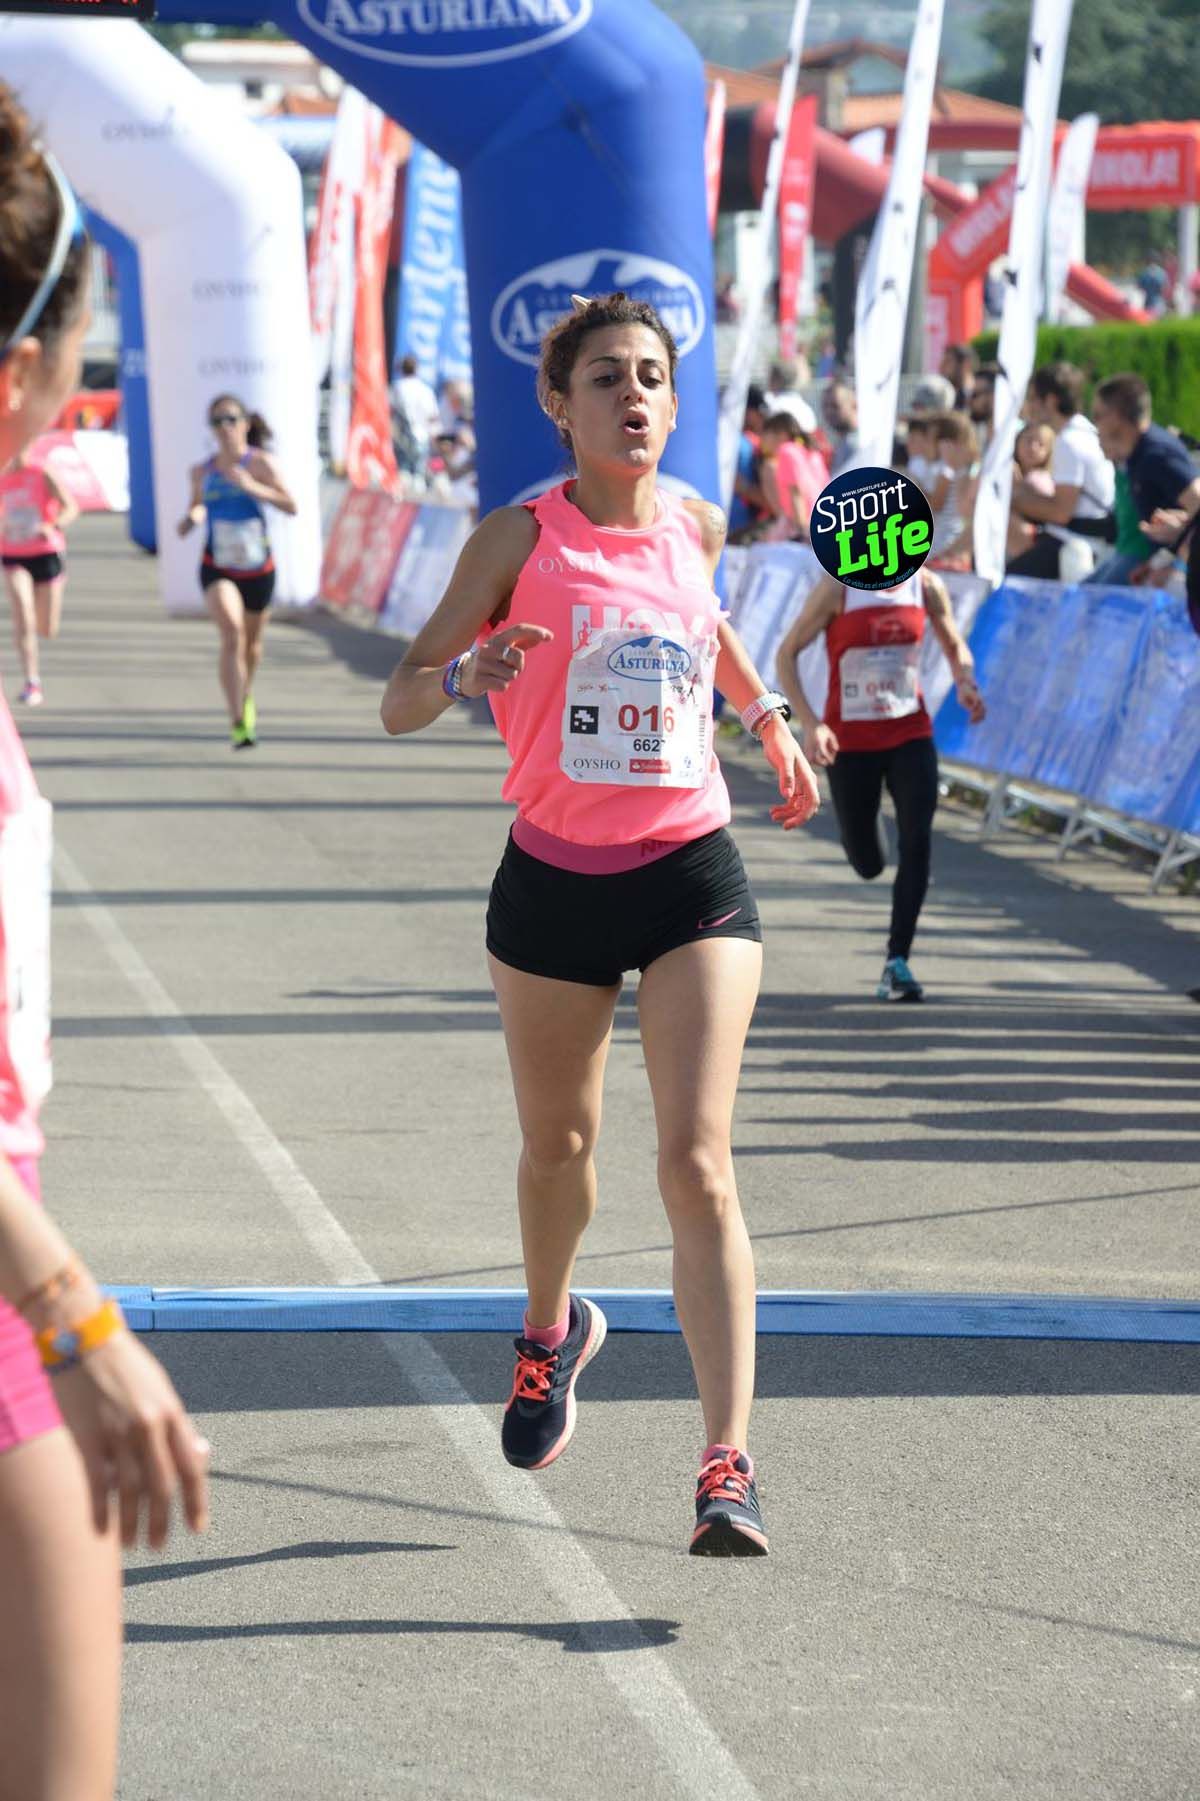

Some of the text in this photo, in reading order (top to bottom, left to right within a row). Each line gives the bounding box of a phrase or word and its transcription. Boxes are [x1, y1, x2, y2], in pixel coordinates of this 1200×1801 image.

[618, 704, 675, 733] 016
[633, 738, 666, 752] 662
[573, 759, 621, 770] OYSHO
